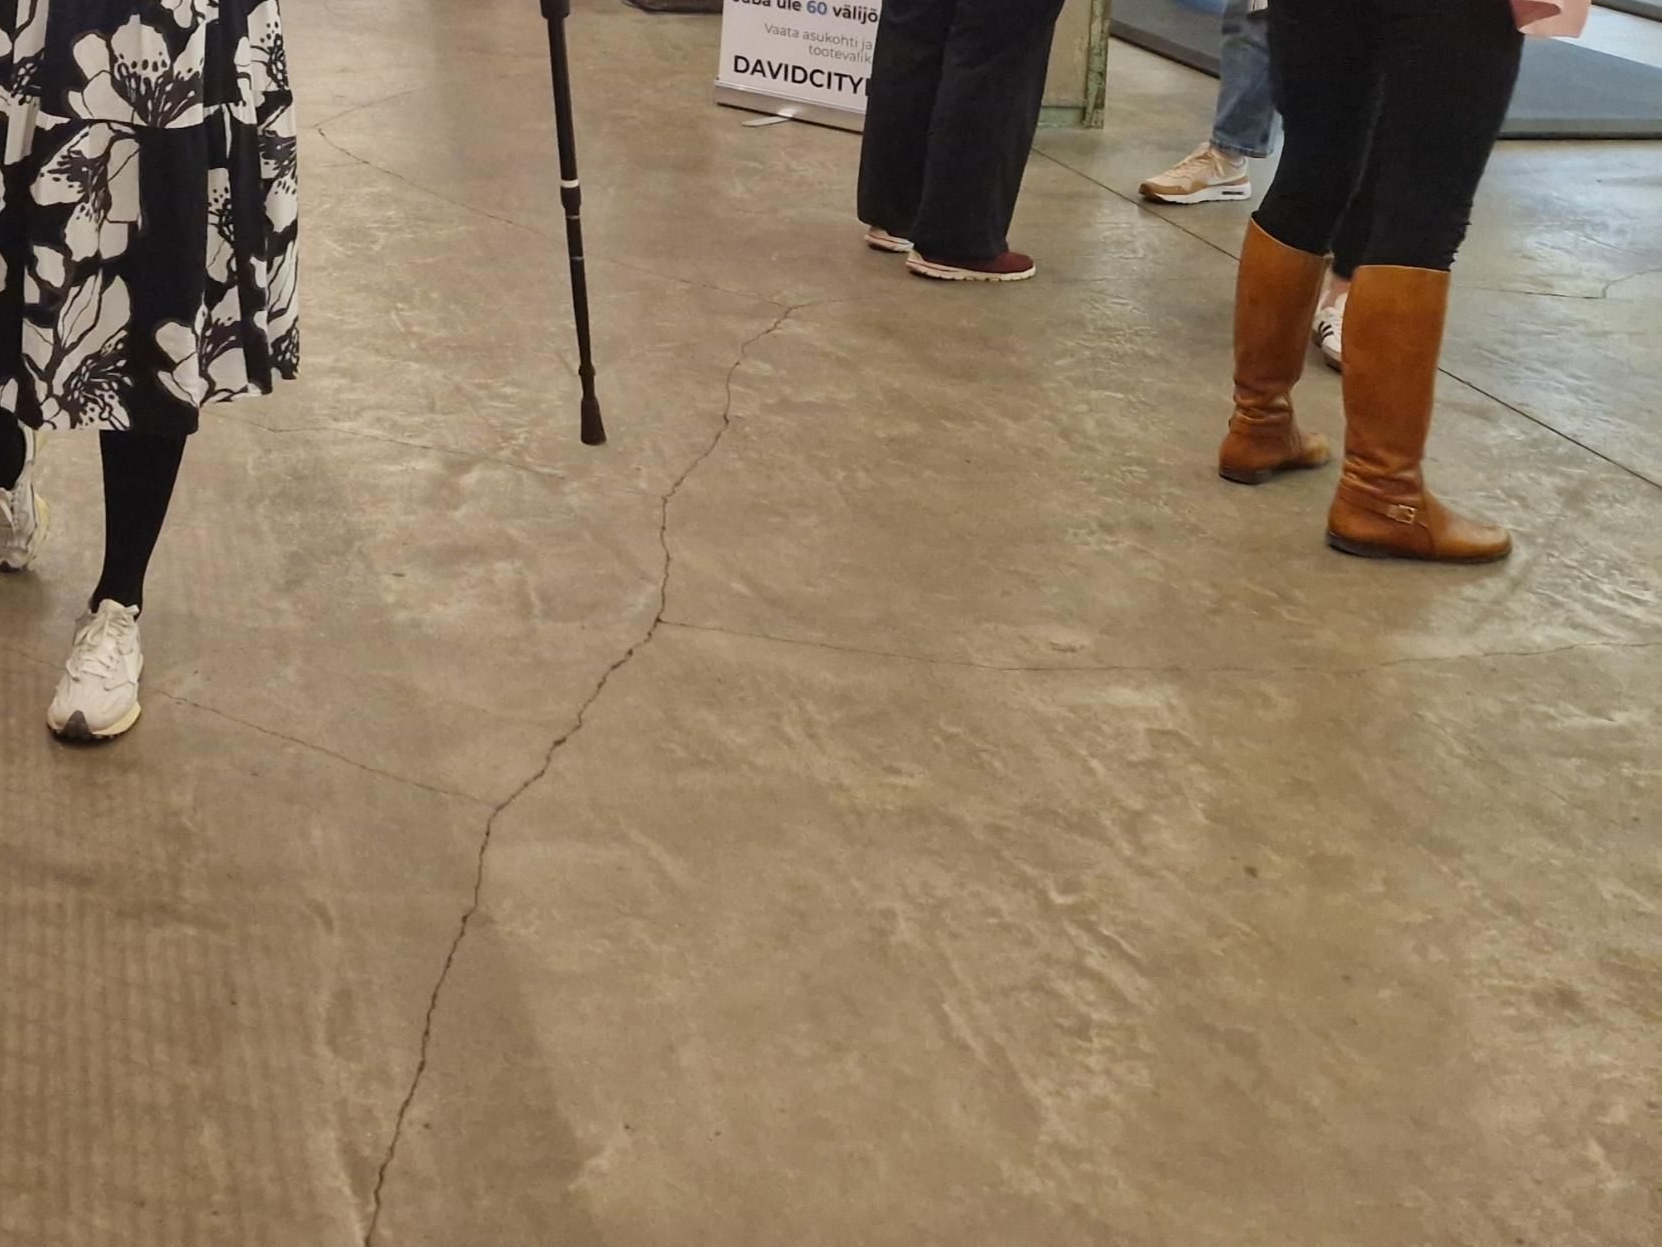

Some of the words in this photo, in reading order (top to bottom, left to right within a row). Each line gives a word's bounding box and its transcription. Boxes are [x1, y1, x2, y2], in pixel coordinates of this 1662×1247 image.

[806, 0, 828, 16] 60
[832, 4, 879, 25] välijõ
[764, 23, 799, 39] Vaata
[802, 30, 858, 49] asukohti
[861, 38, 873, 52] ja
[808, 45, 872, 64] tootevalik
